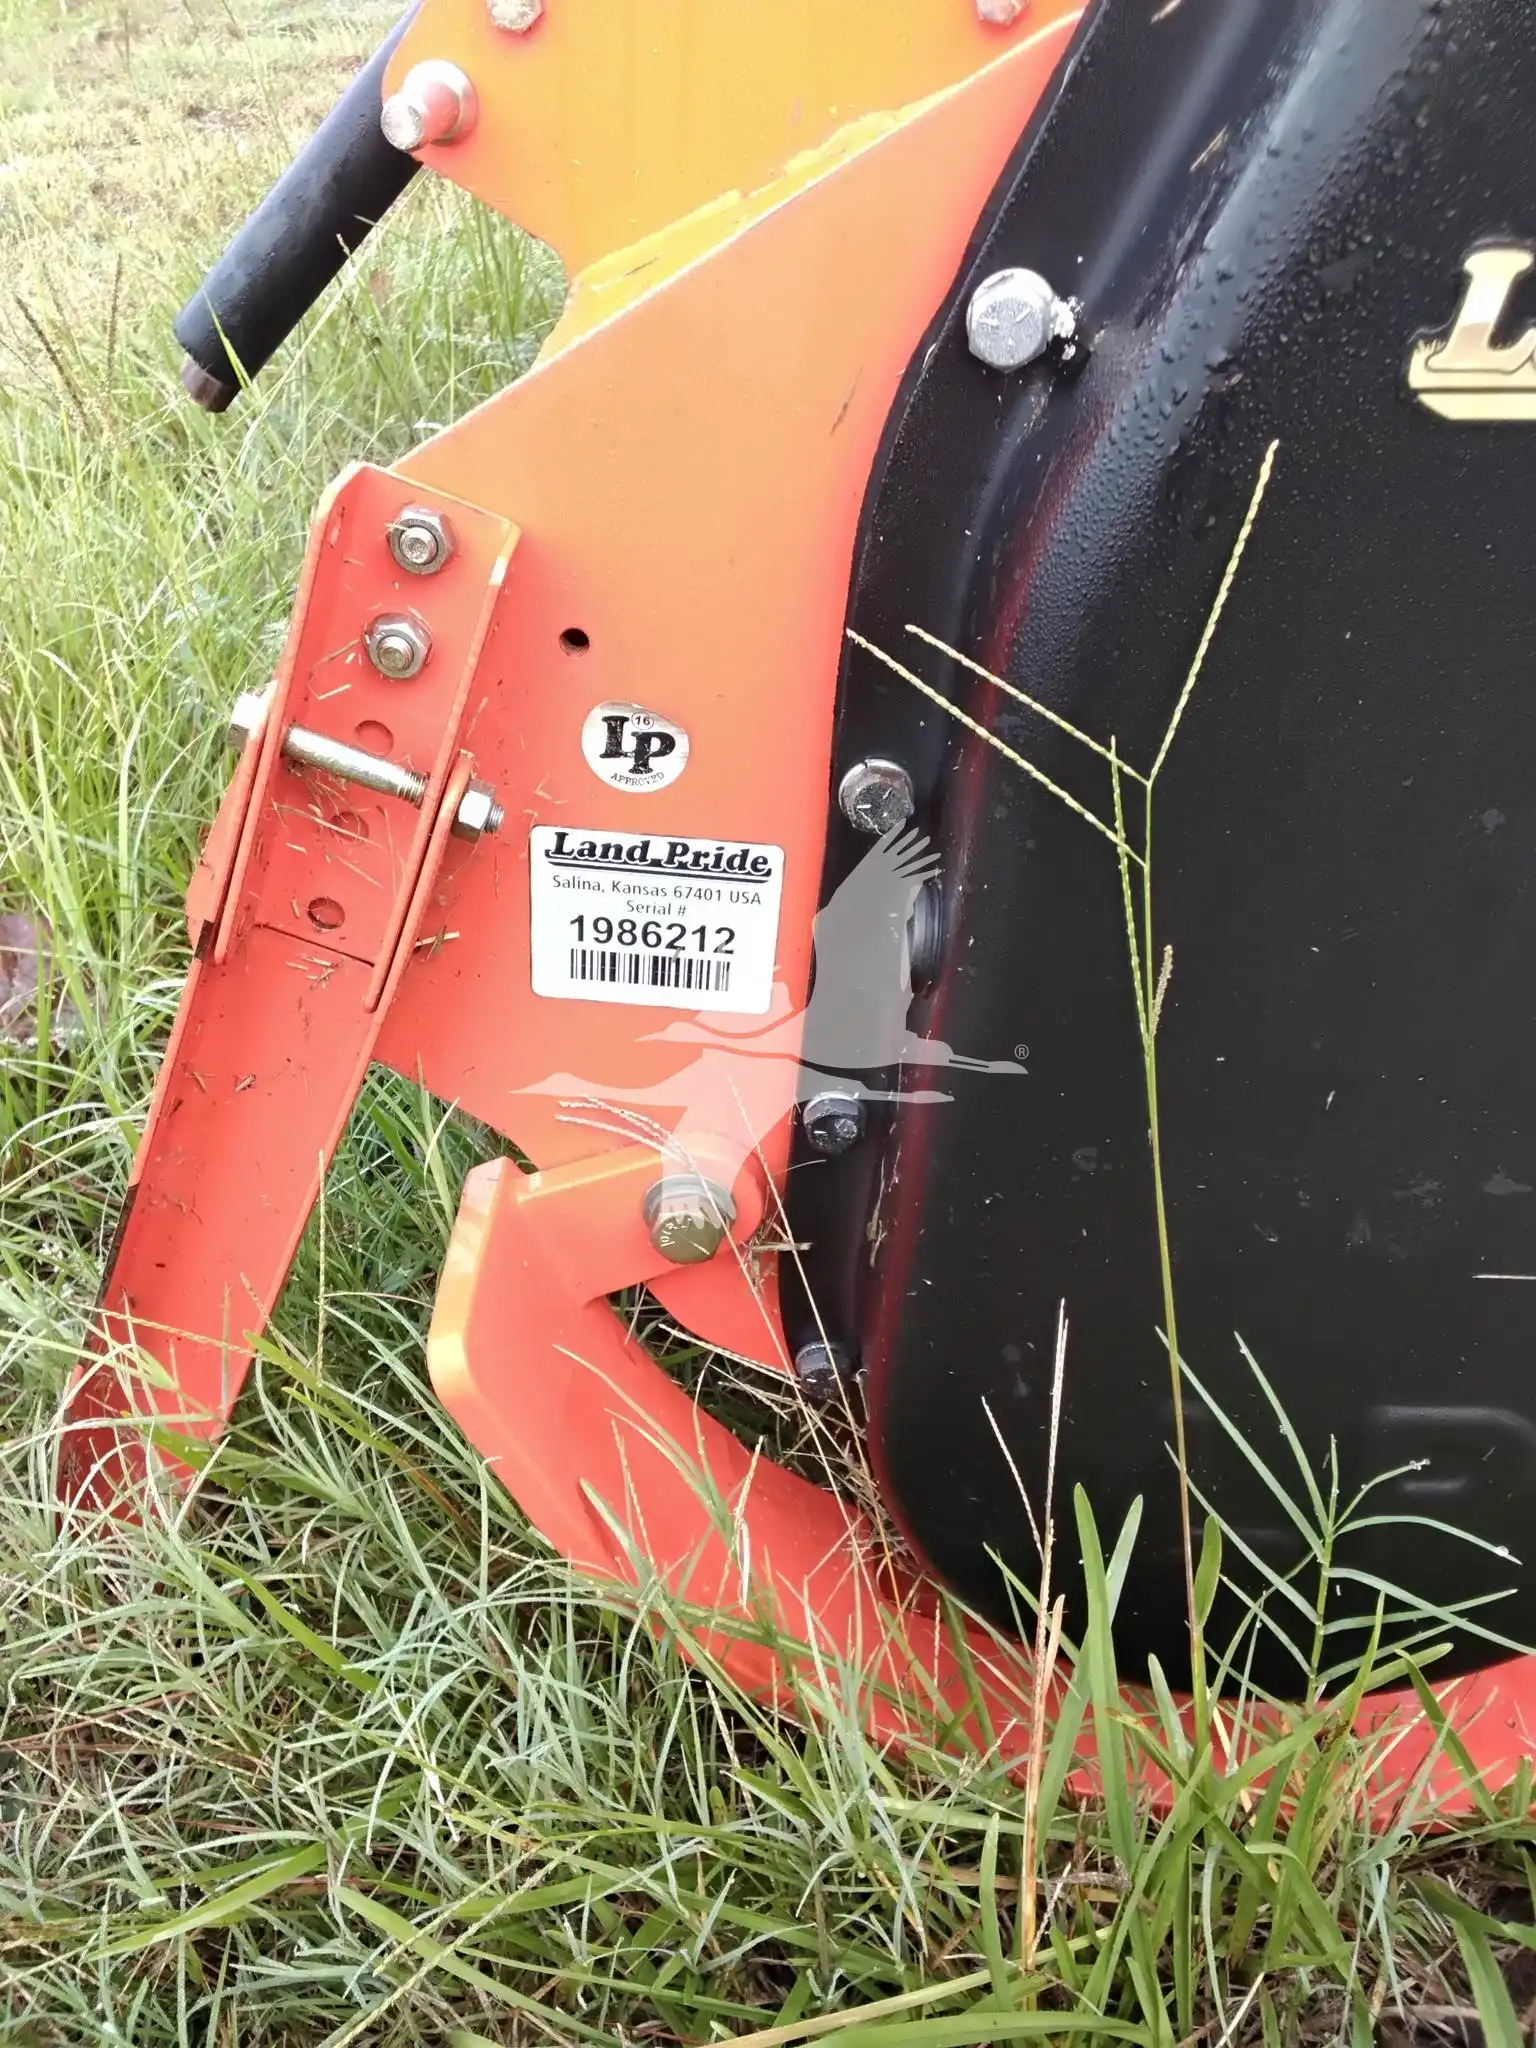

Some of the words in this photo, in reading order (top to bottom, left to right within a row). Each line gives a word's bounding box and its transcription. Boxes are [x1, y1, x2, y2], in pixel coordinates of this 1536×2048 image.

[1425, 249, 1536, 375] L
[635, 715, 651, 726] 16
[599, 715, 676, 775] LP
[610, 772, 665, 787] APPROVED
[546, 831, 651, 866] Land
[666, 841, 772, 877] Pride
[552, 875, 605, 894] Salina,
[612, 880, 667, 897] Kansas
[673, 885, 722, 902] 67401
[729, 890, 762, 906] USA
[626, 899, 672, 916] Serial
[678, 905, 687, 916] #
[569, 914, 736, 955] 1986212
